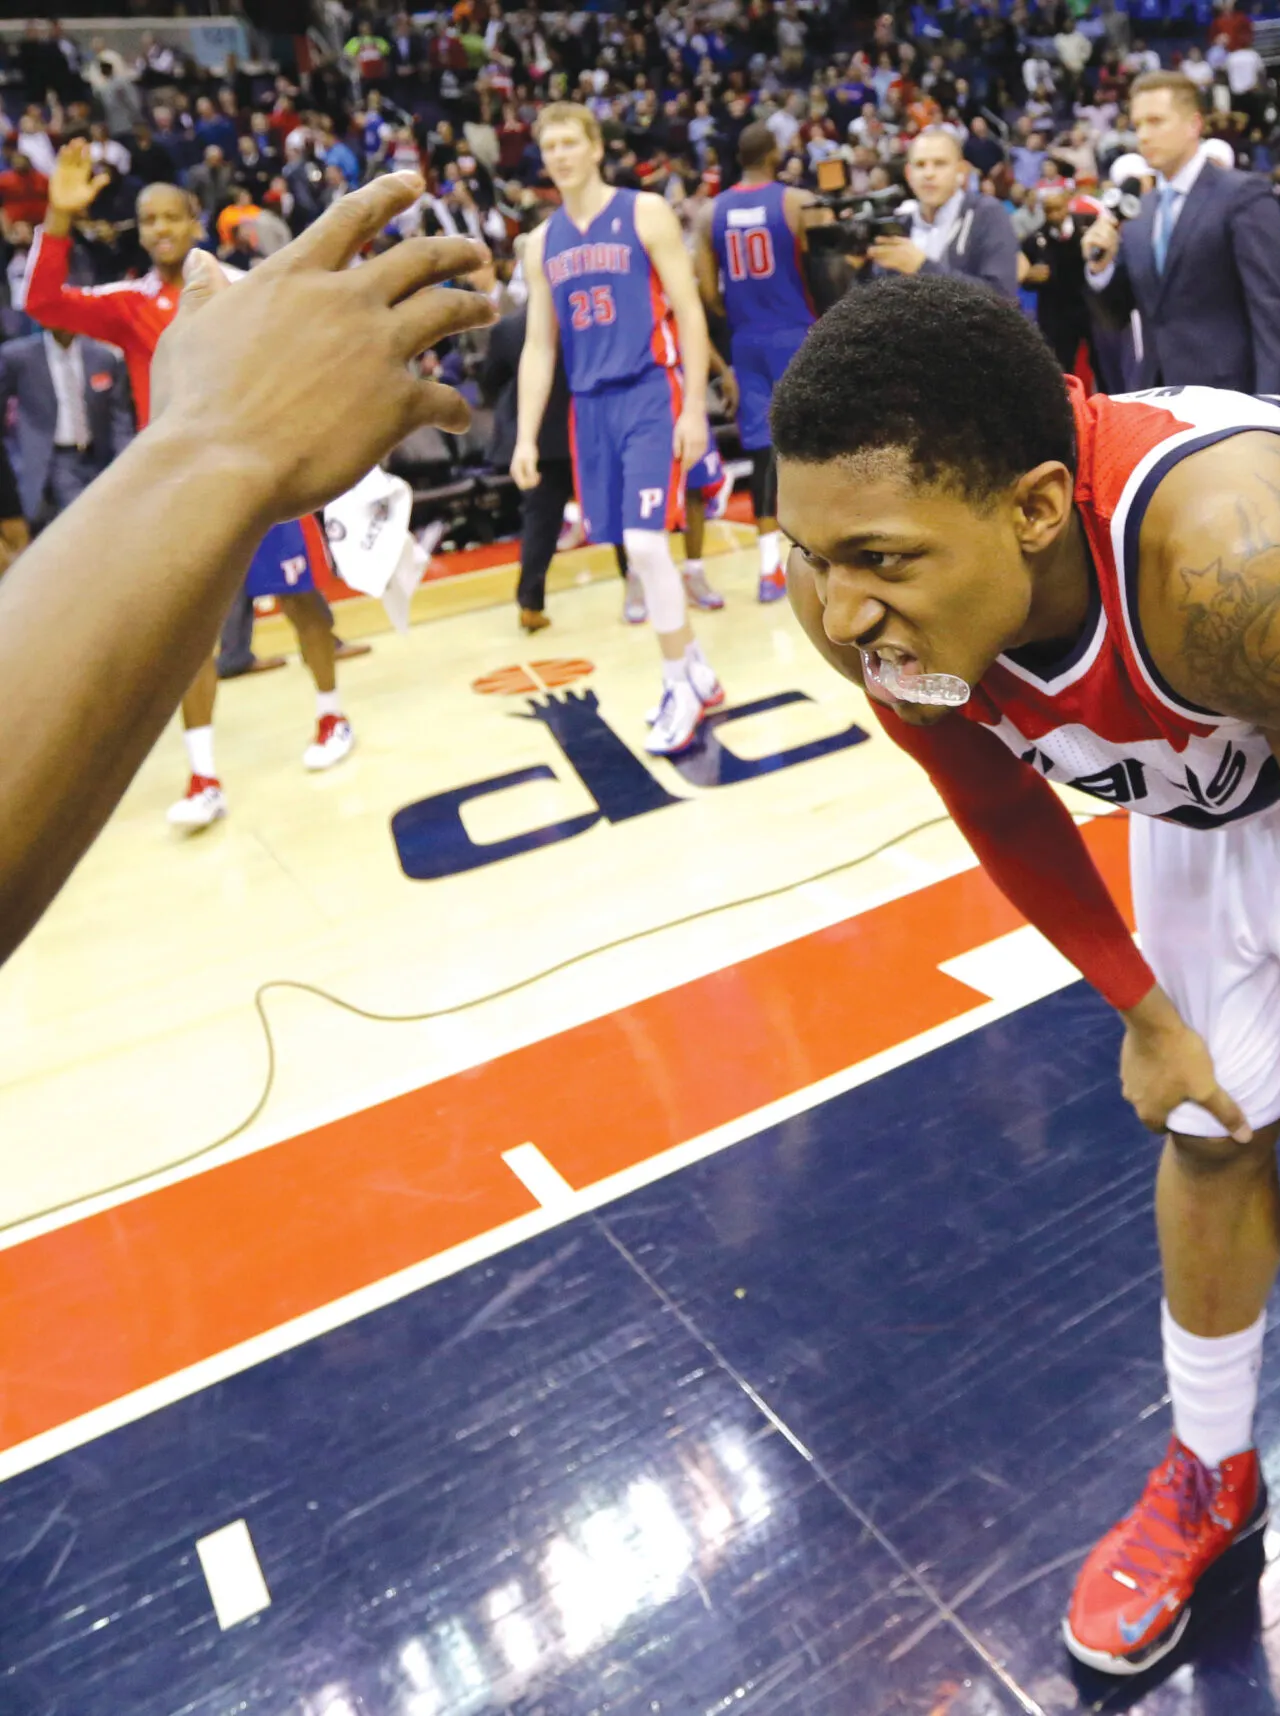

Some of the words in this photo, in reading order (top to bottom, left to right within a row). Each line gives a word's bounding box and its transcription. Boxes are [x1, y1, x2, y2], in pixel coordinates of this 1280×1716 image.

[724, 228, 776, 282] 10
[568, 284, 616, 331] 25
[638, 487, 664, 519] P
[280, 555, 307, 586] P
